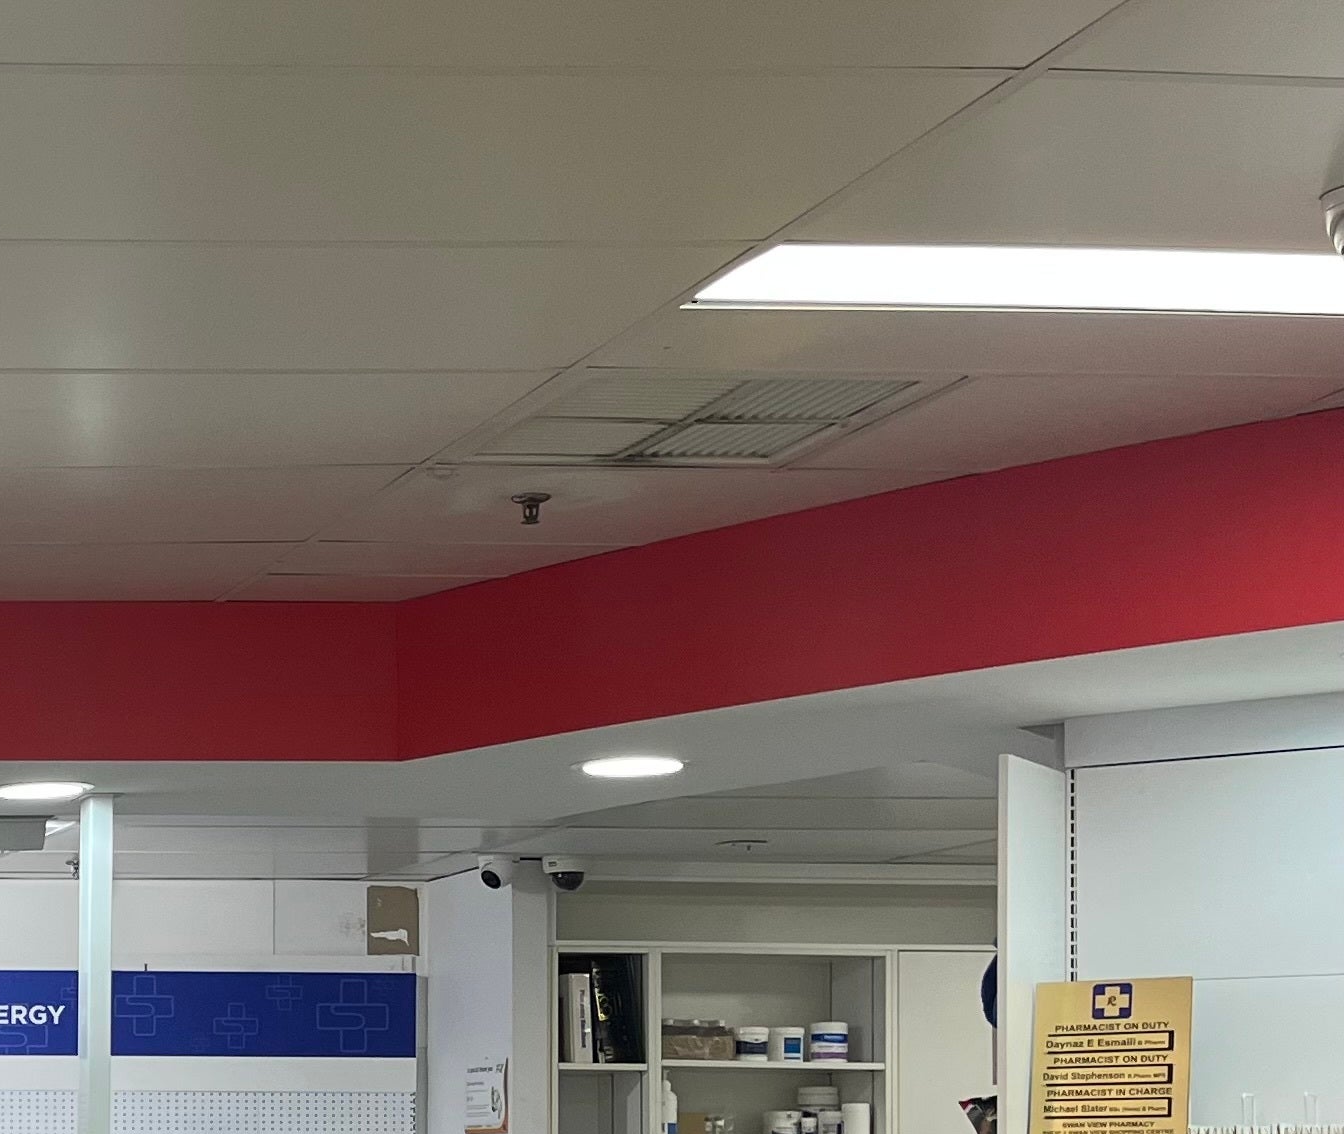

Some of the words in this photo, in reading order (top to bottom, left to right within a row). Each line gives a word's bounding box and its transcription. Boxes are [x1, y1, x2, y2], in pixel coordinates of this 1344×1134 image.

[1055, 1023, 1120, 1032] PHARMACIST
[1054, 1056, 1119, 1064] PHARMACIST
[1047, 1089, 1112, 1097] PHARMACIST
